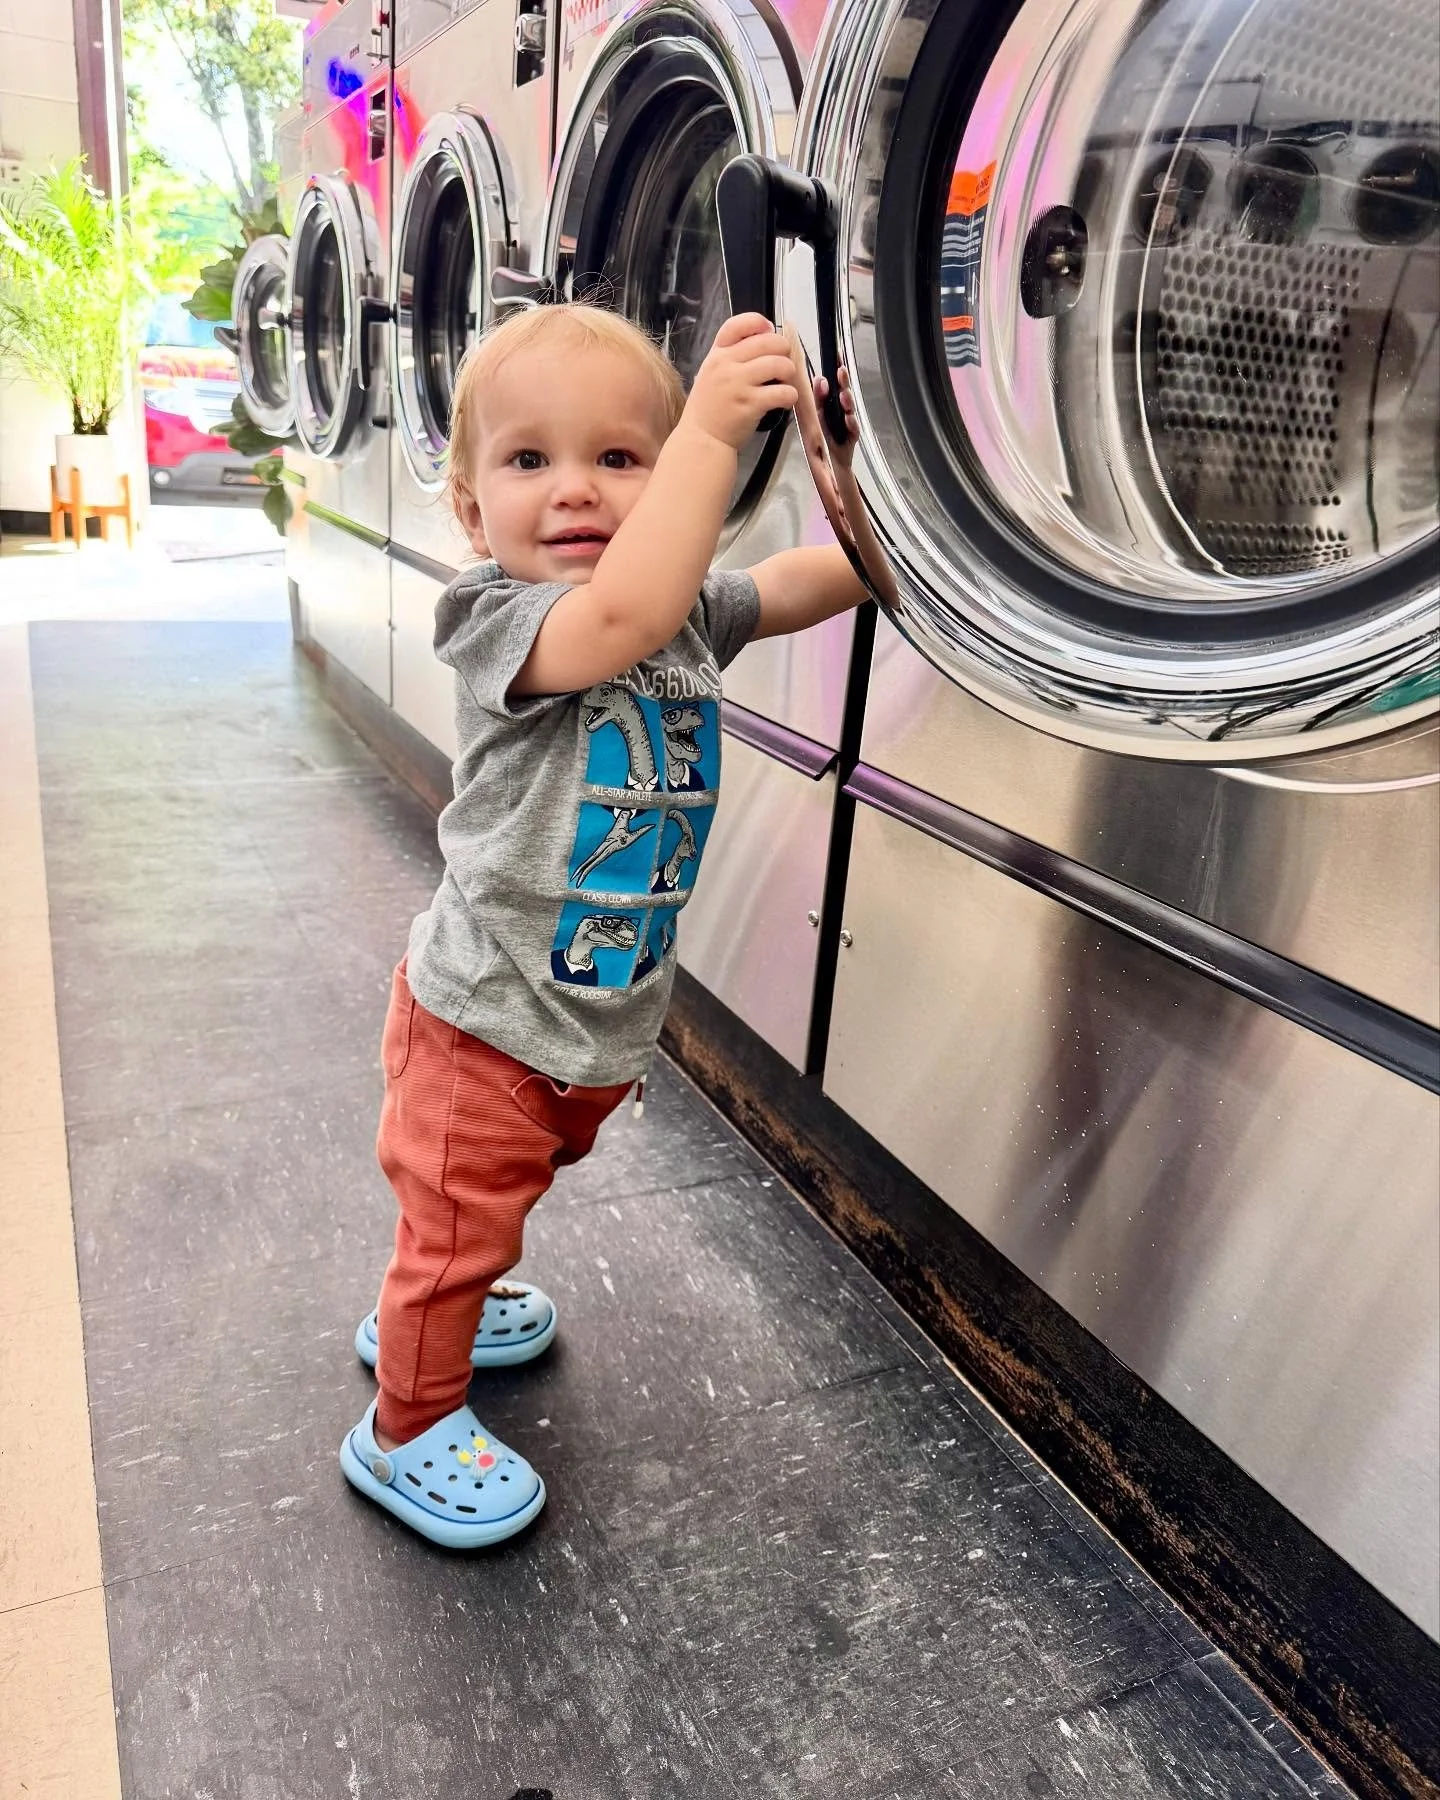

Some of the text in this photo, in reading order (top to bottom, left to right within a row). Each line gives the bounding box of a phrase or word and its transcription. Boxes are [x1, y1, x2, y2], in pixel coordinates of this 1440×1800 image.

[591, 784, 627, 798] ALL-STAR
[582, 892, 632, 905] CLASS CLOWN
